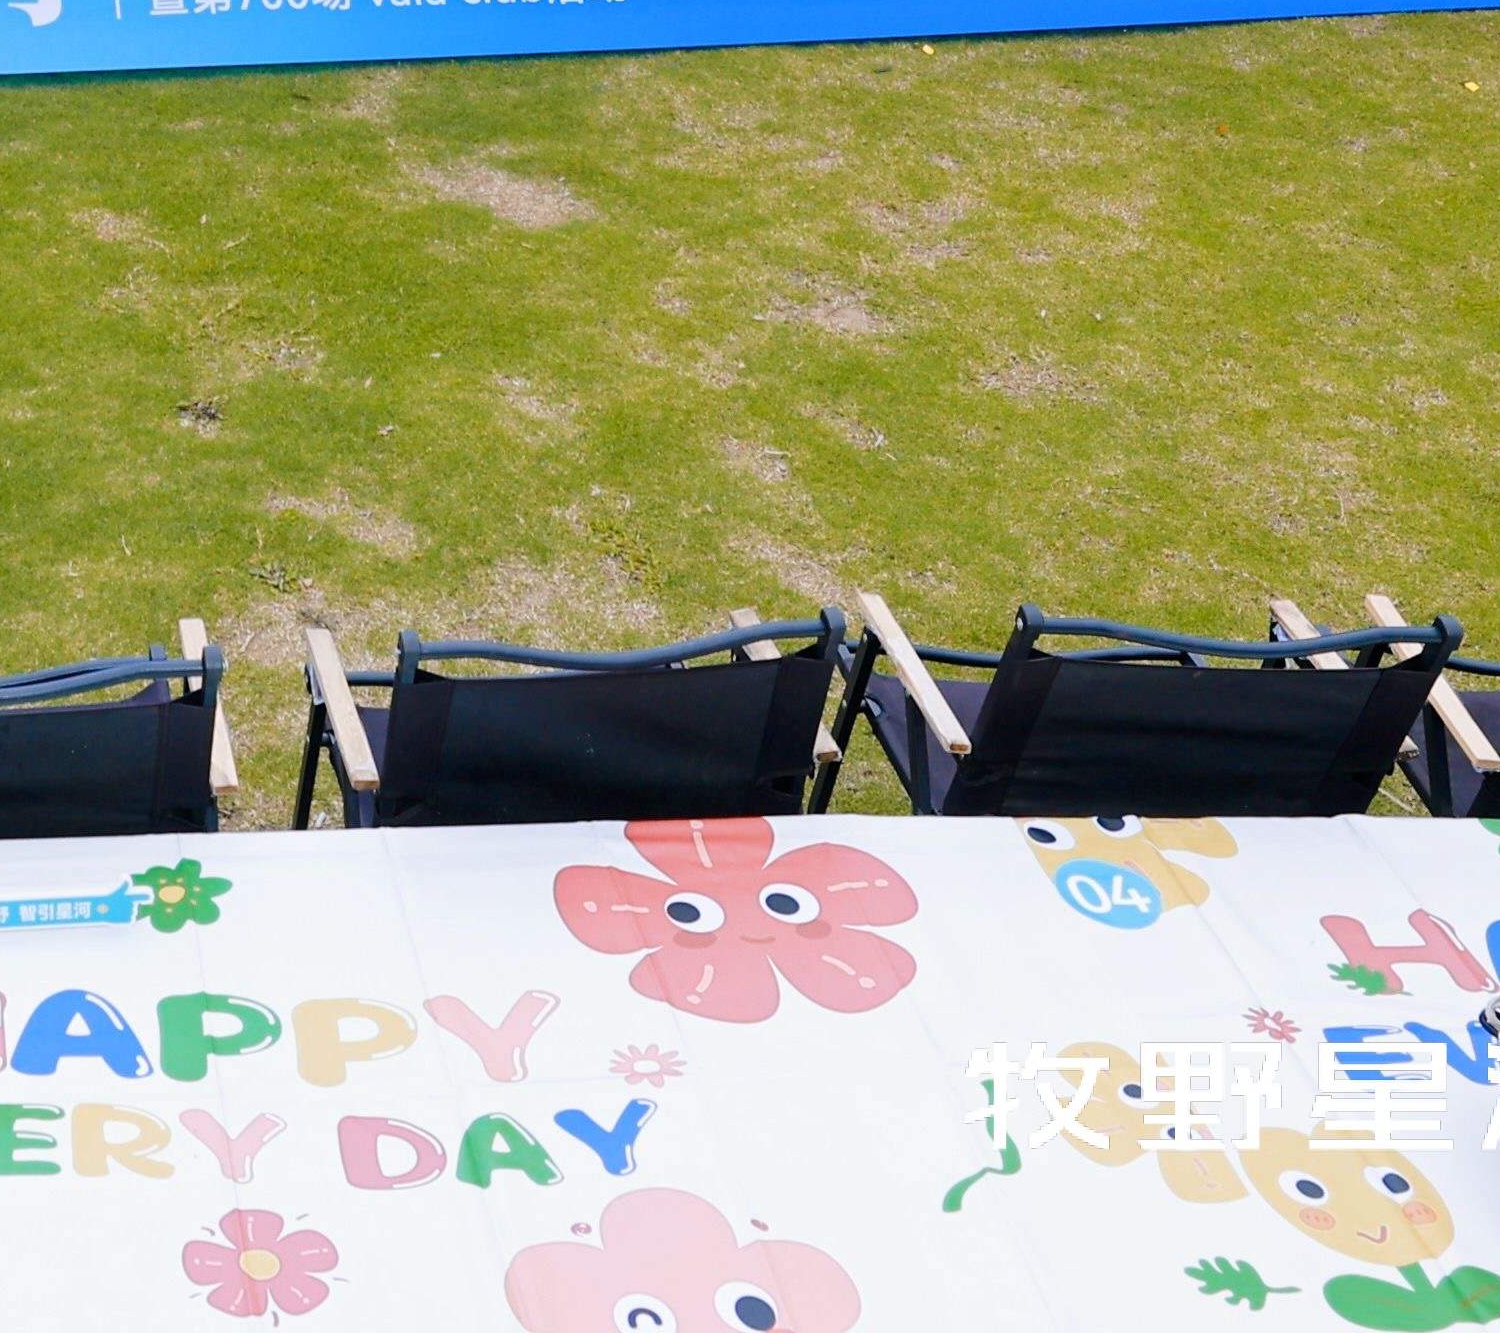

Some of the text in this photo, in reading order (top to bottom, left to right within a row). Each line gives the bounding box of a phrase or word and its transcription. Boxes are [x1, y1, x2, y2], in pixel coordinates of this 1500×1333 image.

[19, 898, 93, 924] 智引星河
[1066, 870, 1153, 919] 04
[338, 1096, 659, 1191] DAY
